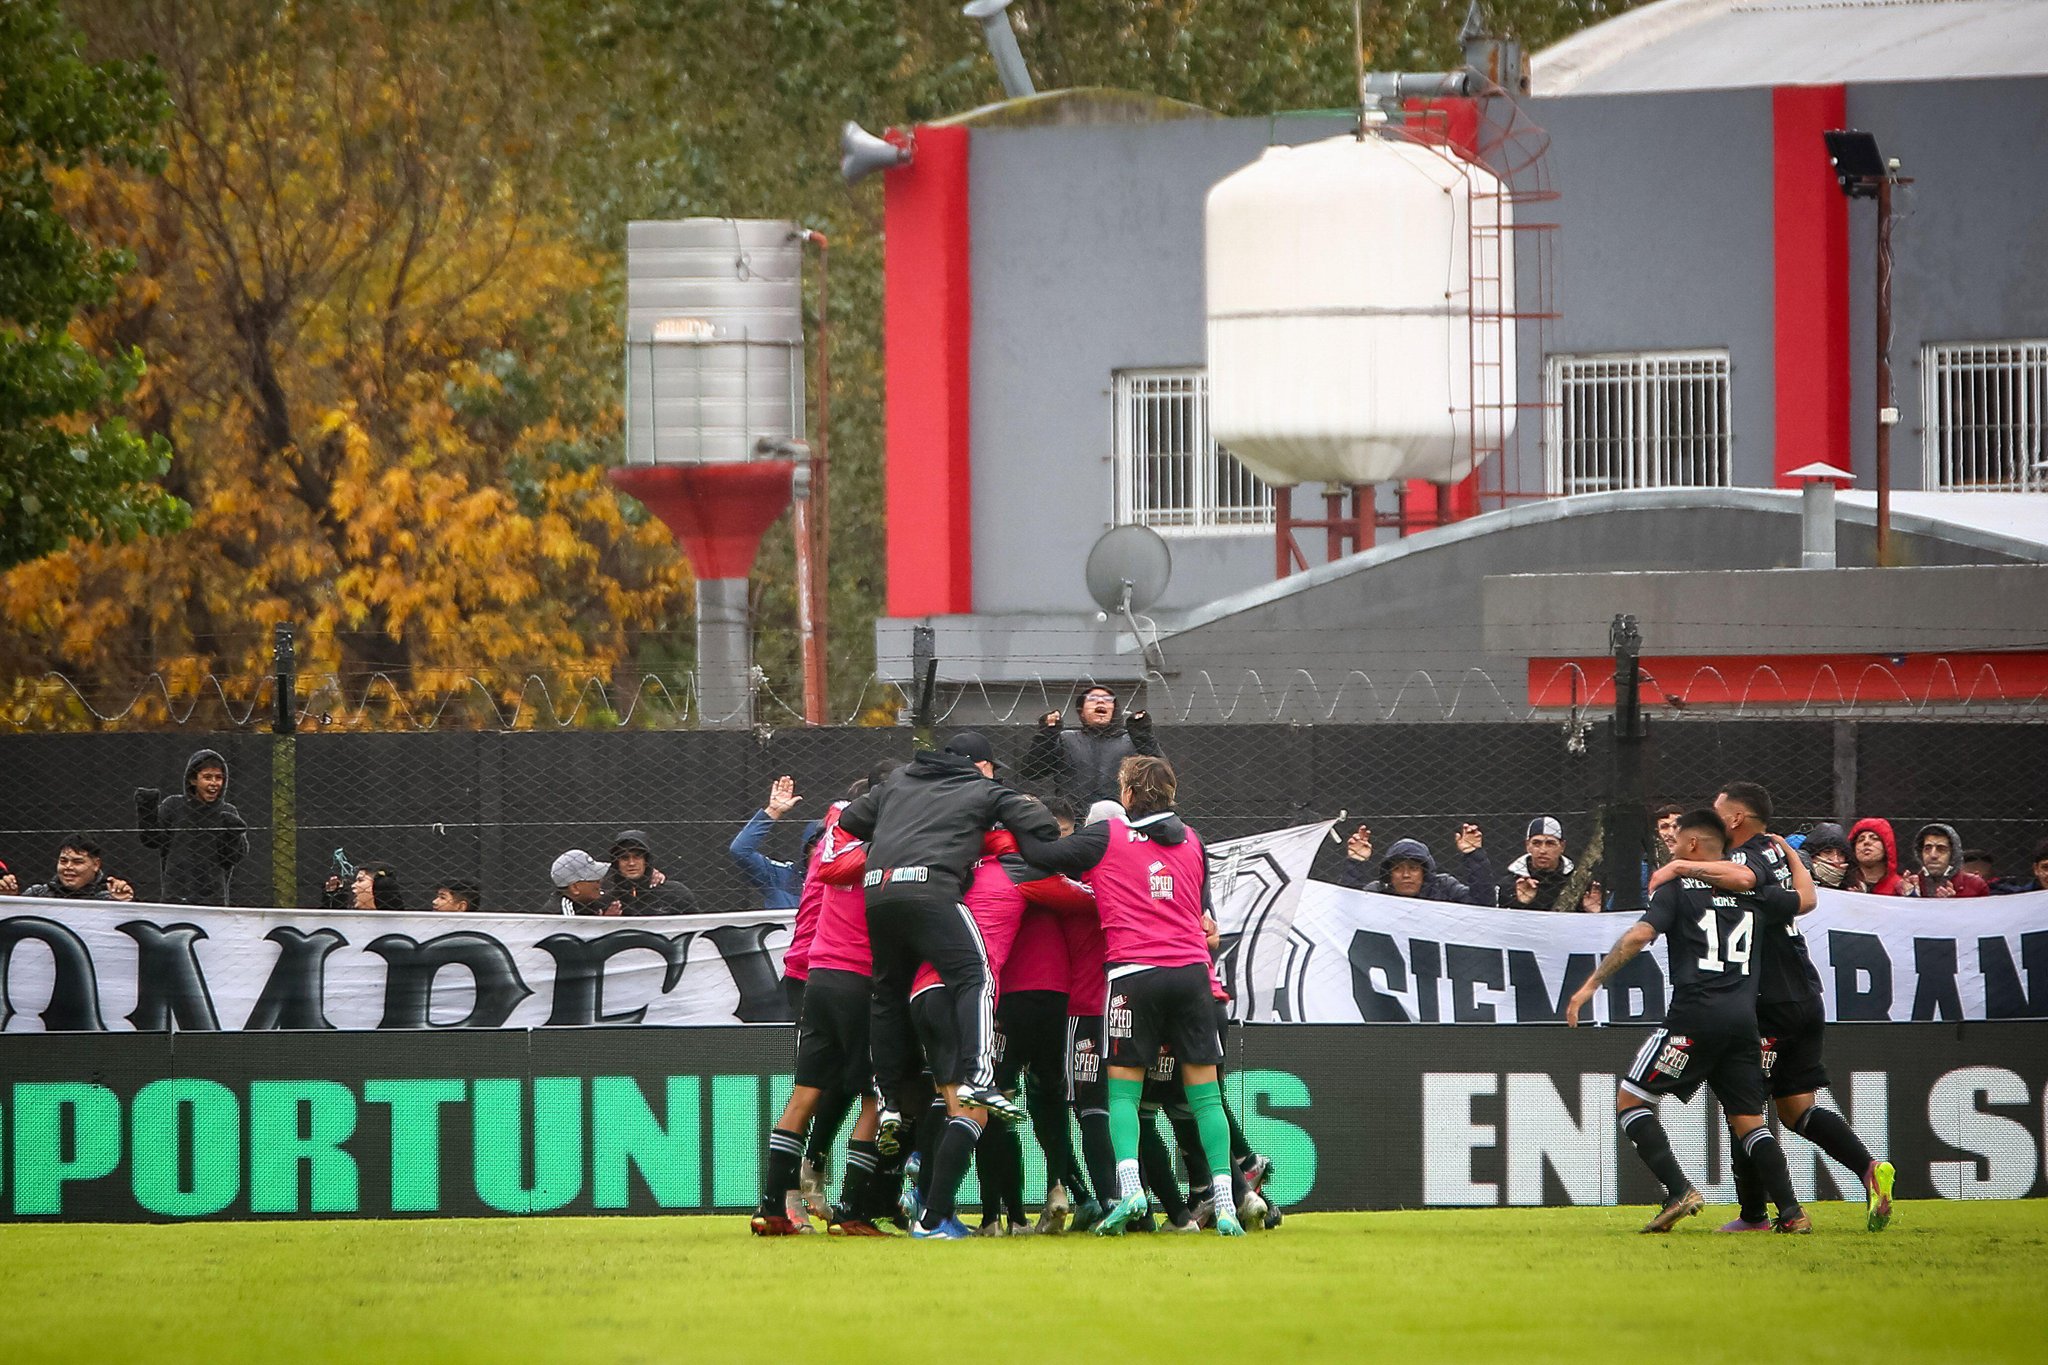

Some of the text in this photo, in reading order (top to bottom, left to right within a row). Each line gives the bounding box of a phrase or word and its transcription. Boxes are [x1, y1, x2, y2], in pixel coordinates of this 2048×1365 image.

[1149, 875, 1173, 891] SPEED
[1697, 909, 1754, 976] 14
[1109, 1007, 1132, 1029] SPEED
[1074, 1052, 1100, 1073] SPEED
[1660, 1045, 1690, 1071] SPEED
[1423, 1072, 1618, 1206] EN
[1927, 1066, 2048, 1200] S
